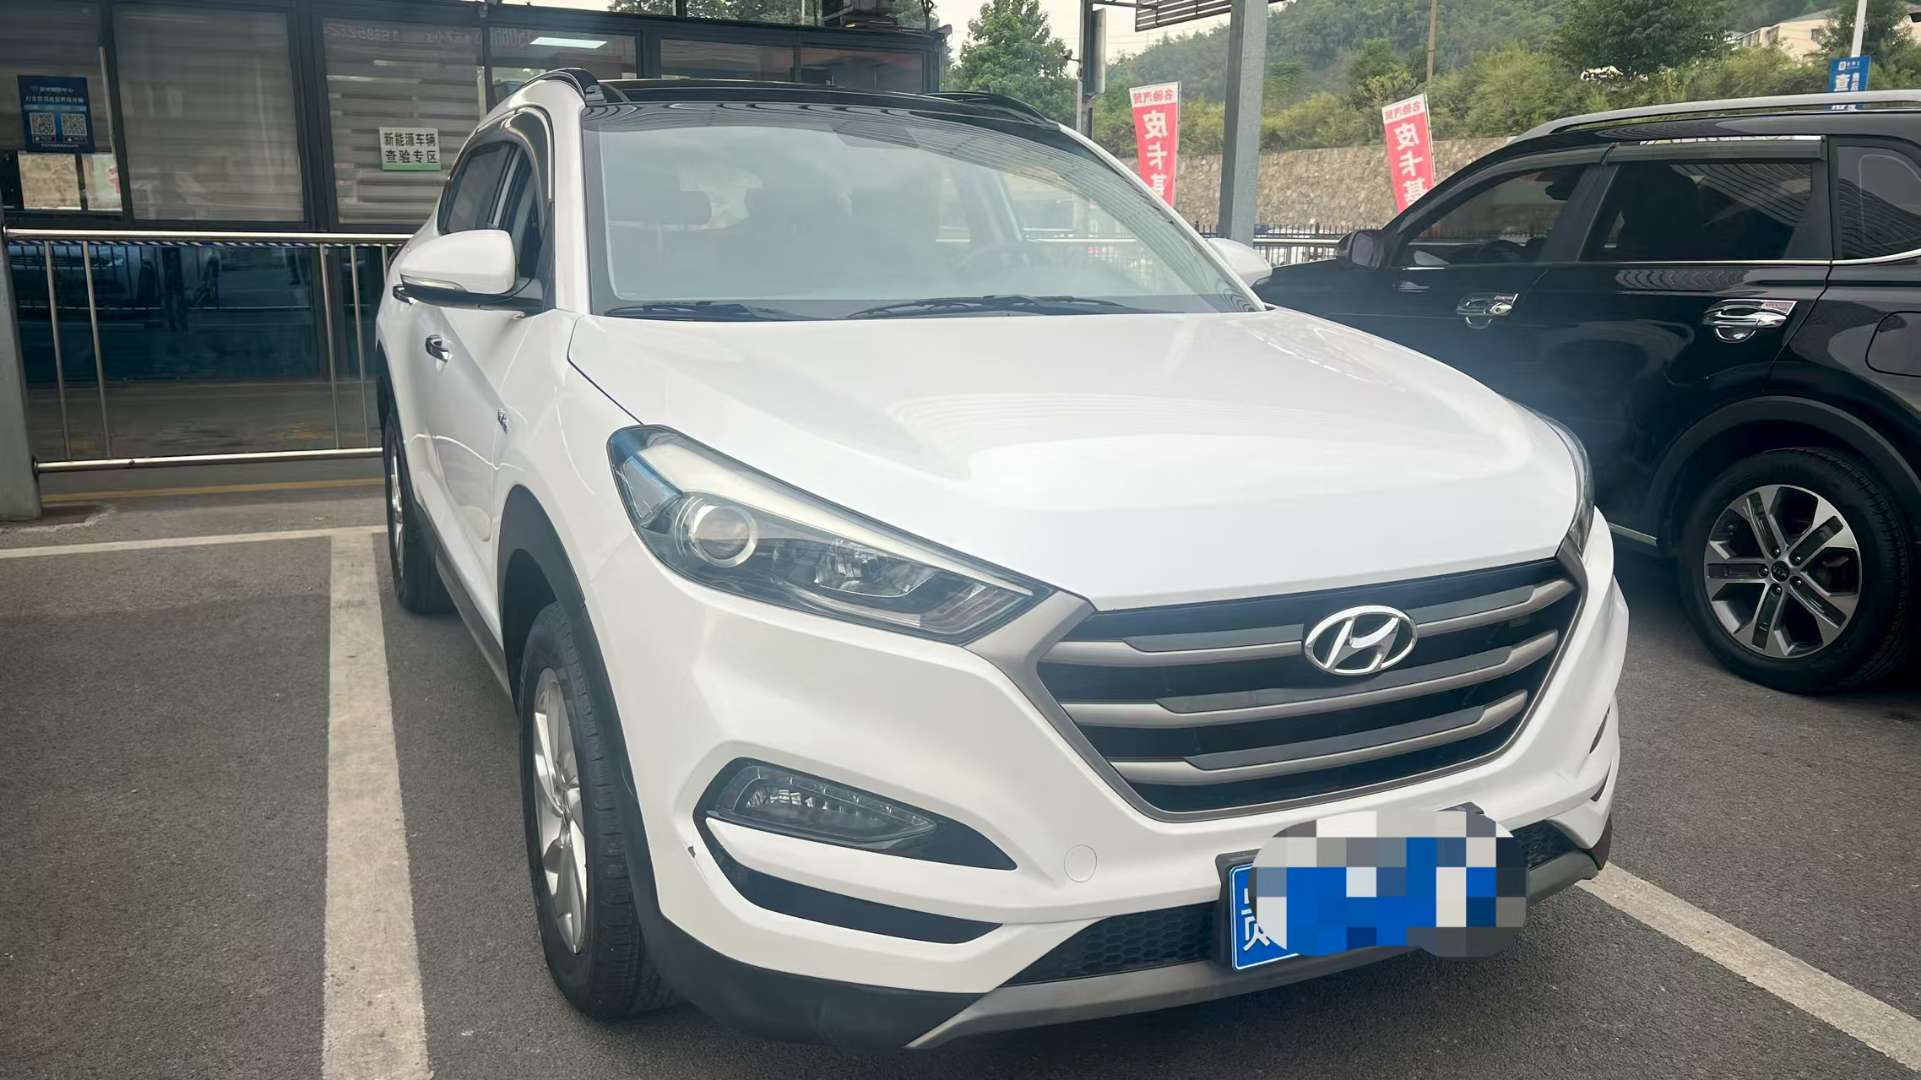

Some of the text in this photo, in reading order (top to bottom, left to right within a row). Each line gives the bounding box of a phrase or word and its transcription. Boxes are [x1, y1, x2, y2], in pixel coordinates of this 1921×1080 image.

[384, 131, 436, 147] 新能源车辆
[385, 149, 438, 164] 查验专区
